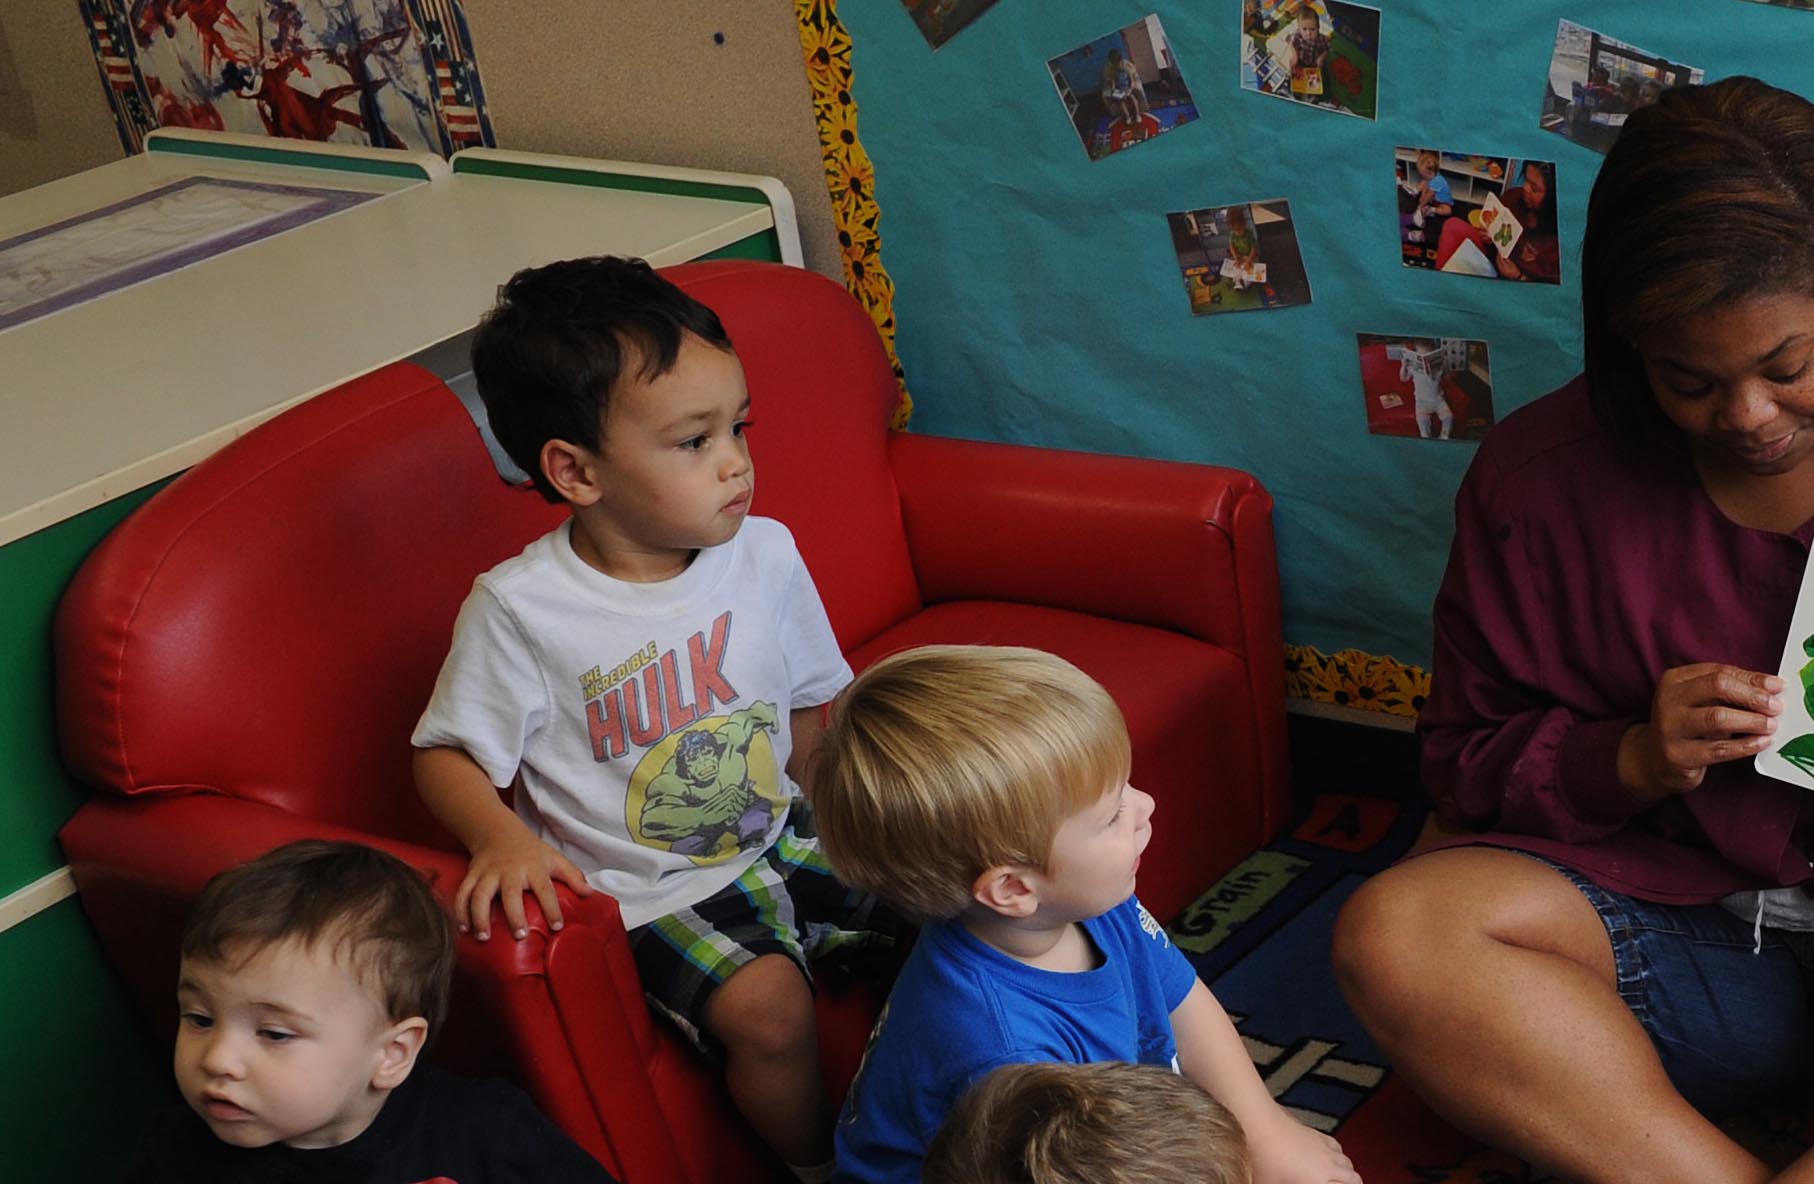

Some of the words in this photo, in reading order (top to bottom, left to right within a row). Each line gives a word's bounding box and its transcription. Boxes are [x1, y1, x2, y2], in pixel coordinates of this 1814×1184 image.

[578, 664, 601, 687] THE
[582, 640, 658, 701] INCREDIBLE
[584, 609, 740, 763] HULK
[1318, 802, 1361, 840] A
[1170, 869, 1271, 937] Grain
